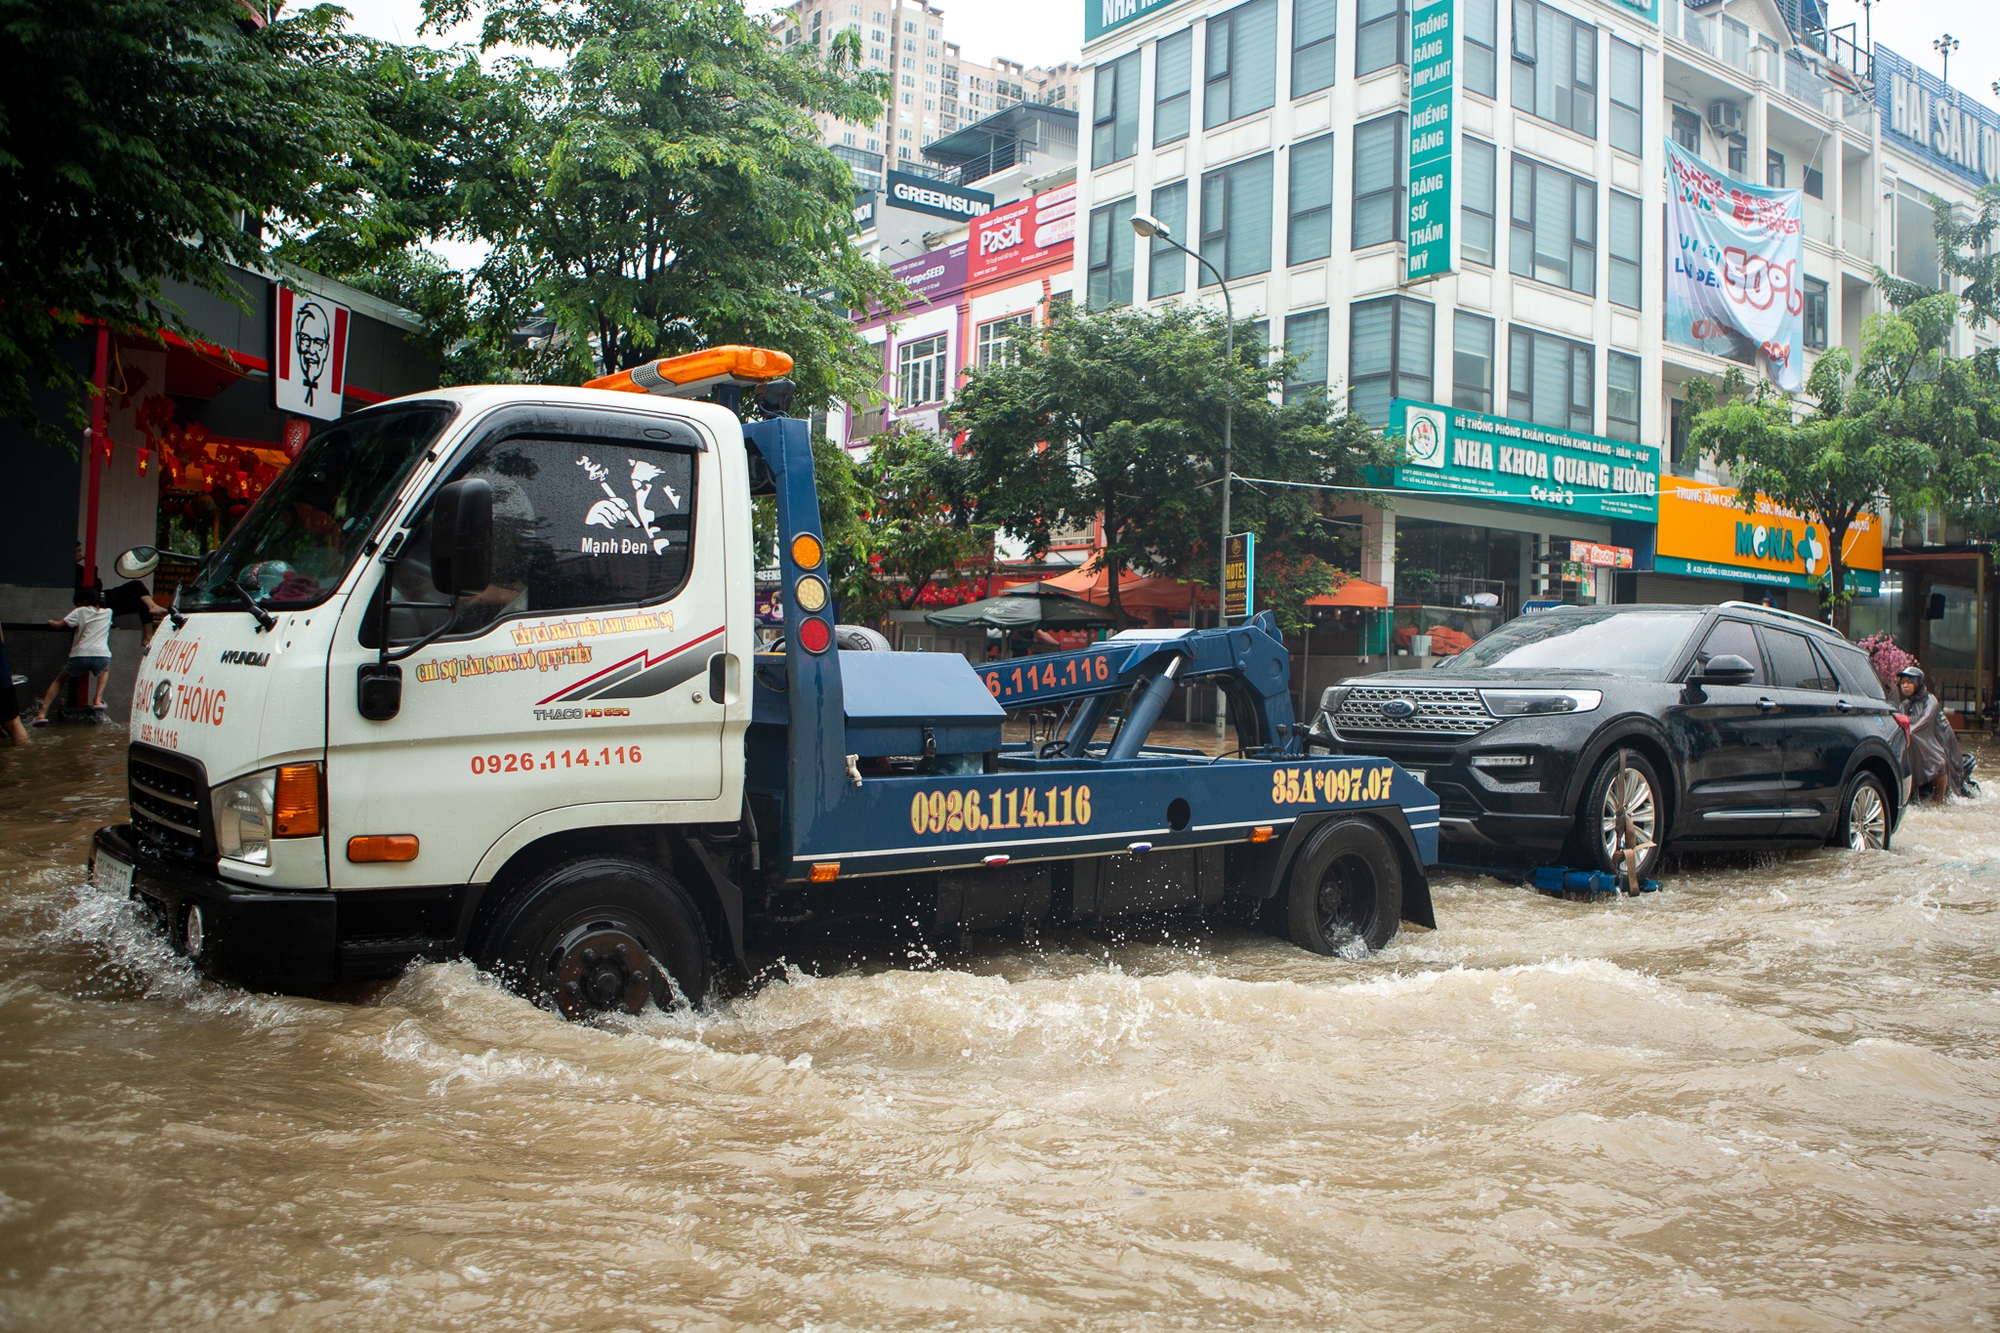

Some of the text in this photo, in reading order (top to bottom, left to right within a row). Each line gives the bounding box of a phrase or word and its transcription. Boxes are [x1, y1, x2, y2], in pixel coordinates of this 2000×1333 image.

[1413, 39, 1443, 64] RĂNG
[1413, 60, 1451, 88] IMPLANT
[1890, 63, 1931, 147] HẢI
[1932, 88, 1979, 173] SẢN
[1412, 130, 1444, 155] RĂNG
[1411, 173, 1443, 198] RĂNG
[893, 182, 991, 217] GREENSUM
[1411, 199, 1429, 222] SỨ
[1410, 220, 1443, 247] THẨM
[1410, 250, 1429, 272] MỸ
[904, 265, 945, 285] GrapeSEED
[1723, 246, 1803, 317] 50%
[1455, 414, 1465, 430] HỆ
[1467, 415, 1493, 433] THỐNG
[1495, 422, 1521, 437] PHÒNG
[1522, 428, 1544, 443] KHÁM
[1545, 433, 1572, 448] CHUYÊN
[1573, 438, 1592, 451] KHOA
[1453, 437, 1494, 471] NHA
[1498, 445, 1549, 480] KHOA
[1552, 455, 1610, 489] QUANG
[1530, 485, 1574, 505] Cơ sở 3
[1675, 486, 1702, 503] TRUNG
[1703, 489, 1719, 505] TÂM
[581, 537, 648, 557] Mạnh Đen
[1226, 562, 1247, 580] HOTEL
[602, 617, 623, 634] ANH
[623, 611, 658, 632] KHÔNG
[659, 609, 675, 633] SỢ
[220, 650, 271, 667] HYUNDAI
[416, 658, 440, 682] CHỈ
[440, 658, 458, 683] SỢ
[459, 654, 485, 677] LÀM
[485, 653, 518, 675] SONG
[518, 648, 536, 670] NÓ
[978, 655, 1109, 698] 6.114.116
[174, 676, 226, 726] THÔNG
[533, 707, 631, 721] THACO HD 650
[470, 745, 643, 775] 0926.114.116
[910, 784, 1092, 835] 0926.114.116
